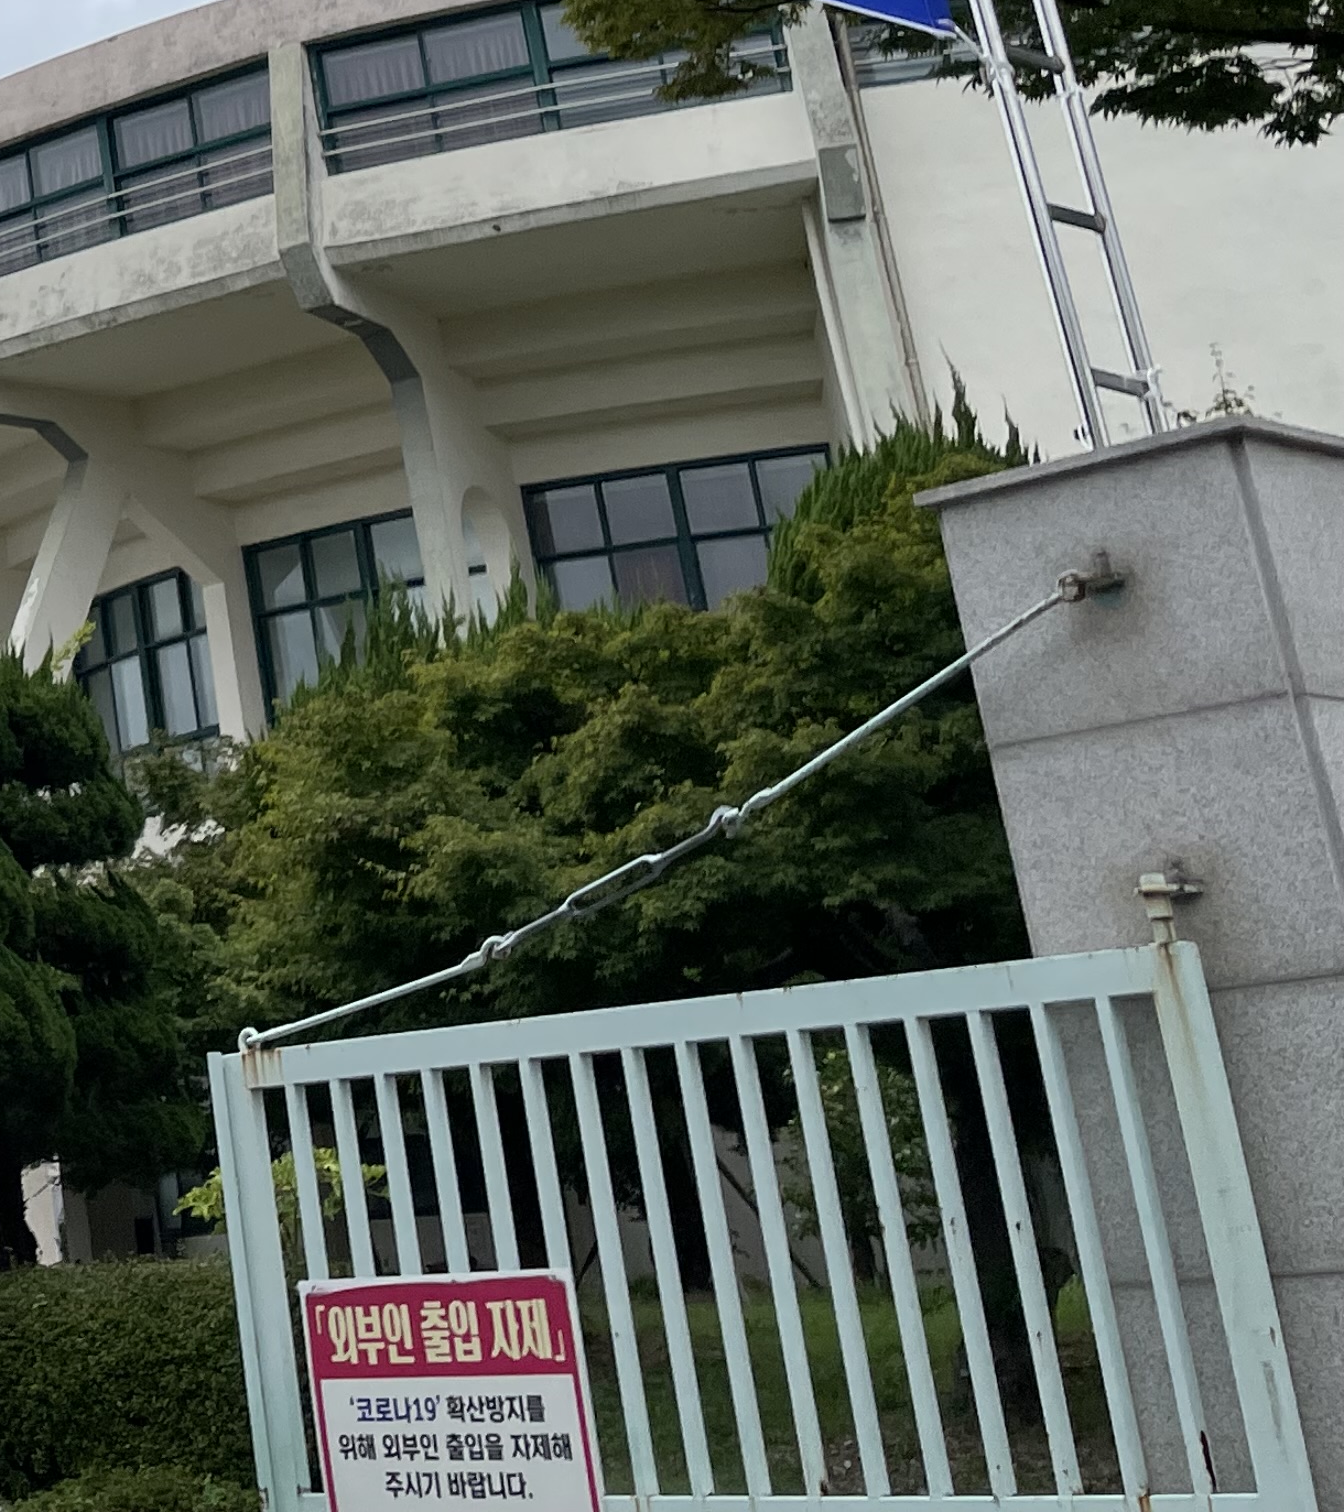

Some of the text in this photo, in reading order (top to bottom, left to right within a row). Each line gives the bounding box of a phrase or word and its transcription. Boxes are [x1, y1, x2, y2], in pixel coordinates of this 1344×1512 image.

[420, 1300, 483, 1363] 출입
[446, 1394, 546, 1423] 확산방지를
[338, 1432, 573, 1461] 위해 외부인 출입을 자제해
[385, 1471, 534, 1500] 주시기 바랍니다.
